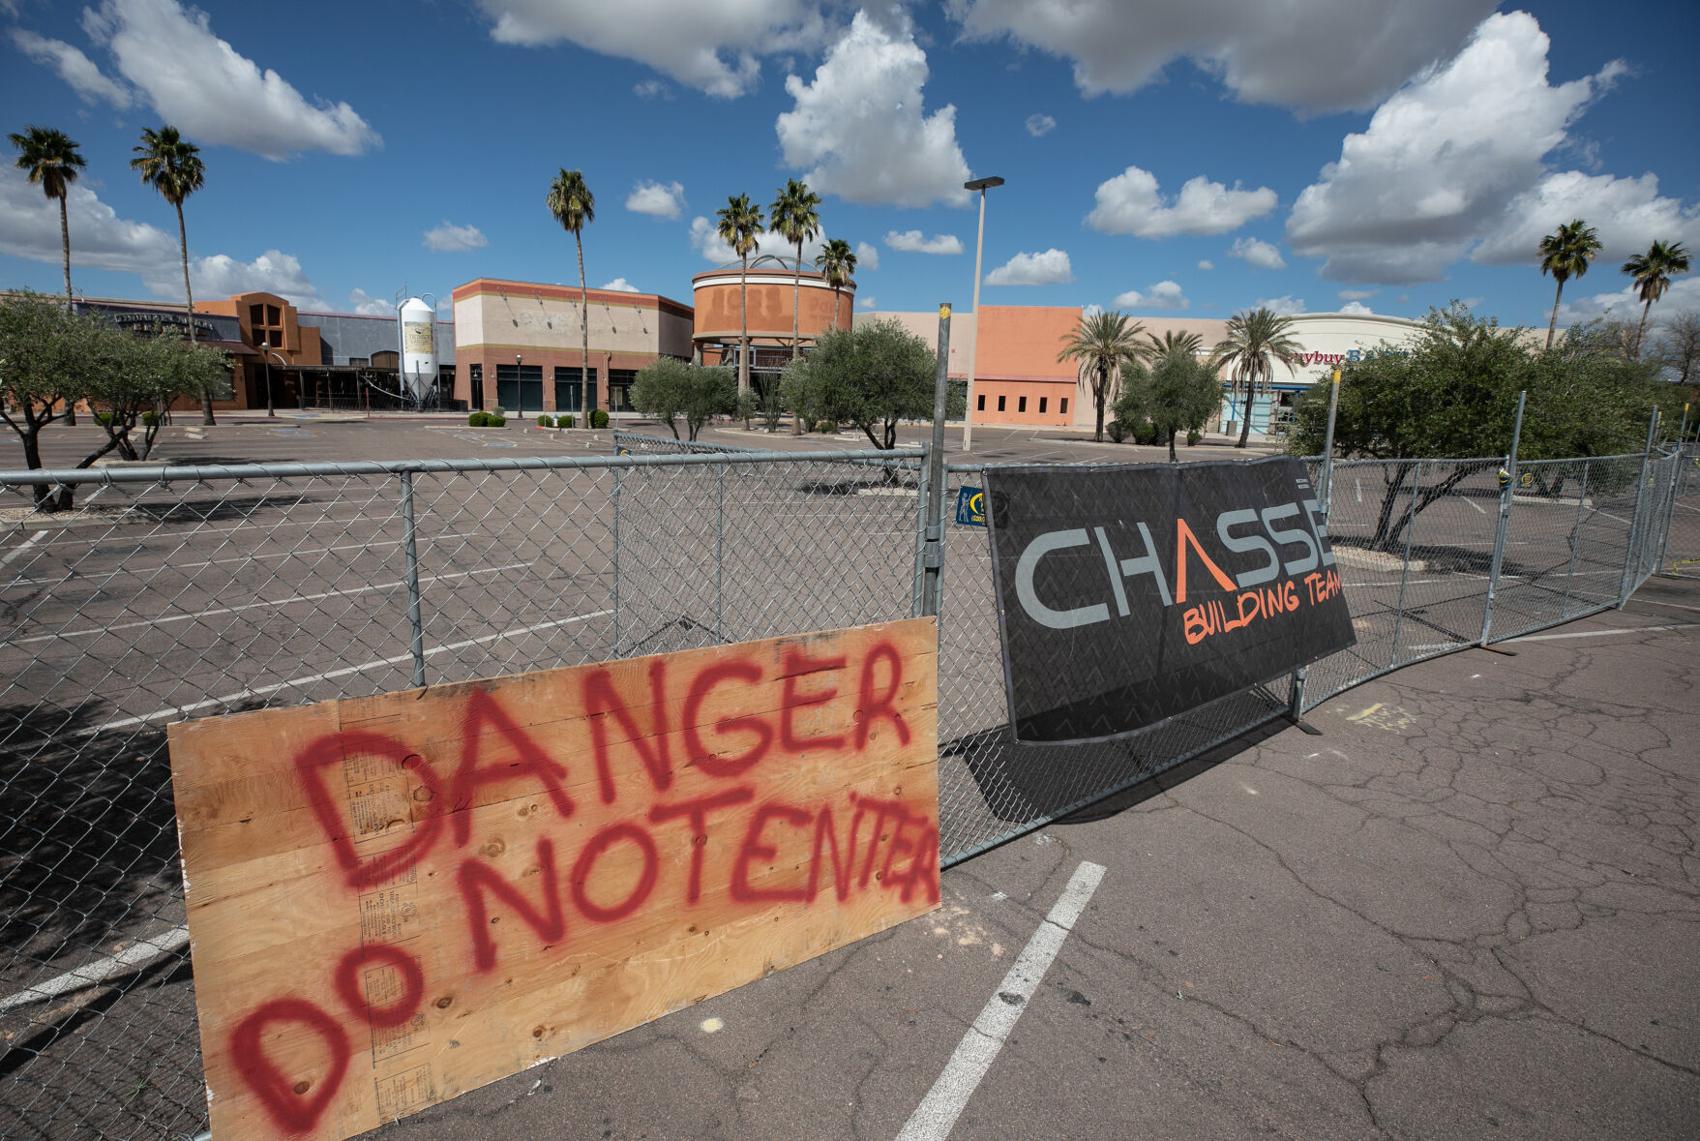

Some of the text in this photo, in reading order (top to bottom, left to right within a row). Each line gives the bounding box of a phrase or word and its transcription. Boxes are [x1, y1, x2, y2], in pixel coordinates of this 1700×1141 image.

[1015, 500, 1336, 629] CHASSE
[1183, 569, 1342, 645] BUILDING TEAM
[296, 640, 910, 890] DANGER
[230, 945, 425, 1135] DO
[457, 787, 755, 972] NOT
[728, 791, 940, 906] ENTER
